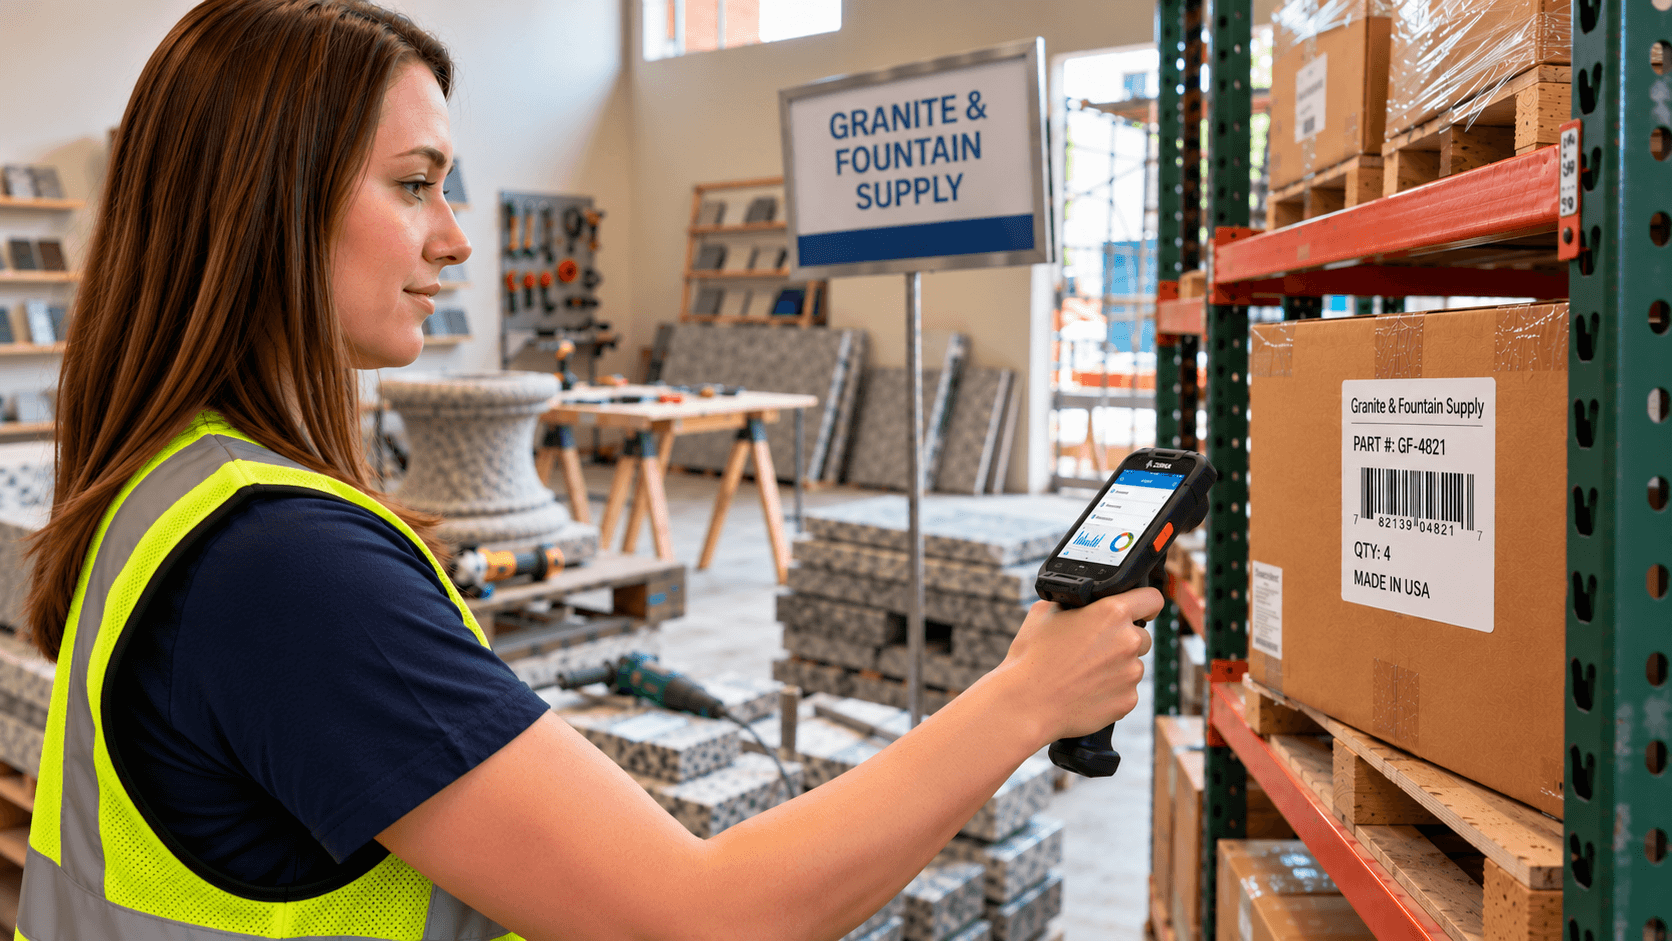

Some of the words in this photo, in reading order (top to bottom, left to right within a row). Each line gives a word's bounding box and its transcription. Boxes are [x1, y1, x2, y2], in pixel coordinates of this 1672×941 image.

[829, 94, 958, 140] GRANITE
[965, 89, 989, 121] &
[834, 130, 982, 175] FOUNTAIN
[855, 172, 964, 210] SUPPLY
[1350, 397, 1386, 414] Granite
[1388, 398, 1397, 414] &
[1398, 397, 1444, 415] Fountain
[1446, 397, 1485, 419] Supply
[1353, 435, 1381, 452] PART
[1384, 437, 1395, 453] #:
[1398, 437, 1446, 456] GF-4821
[1353, 513, 1359, 525] 7
[1378, 516, 1412, 531] 82139
[1419, 520, 1454, 536] 04821
[1477, 530, 1483, 542] 7
[1354, 541, 1381, 560] QTY:
[1383, 545, 1392, 562] 4
[1353, 569, 1387, 591] MADE
[1389, 575, 1402, 594] IN
[1404, 579, 1431, 599] USA
